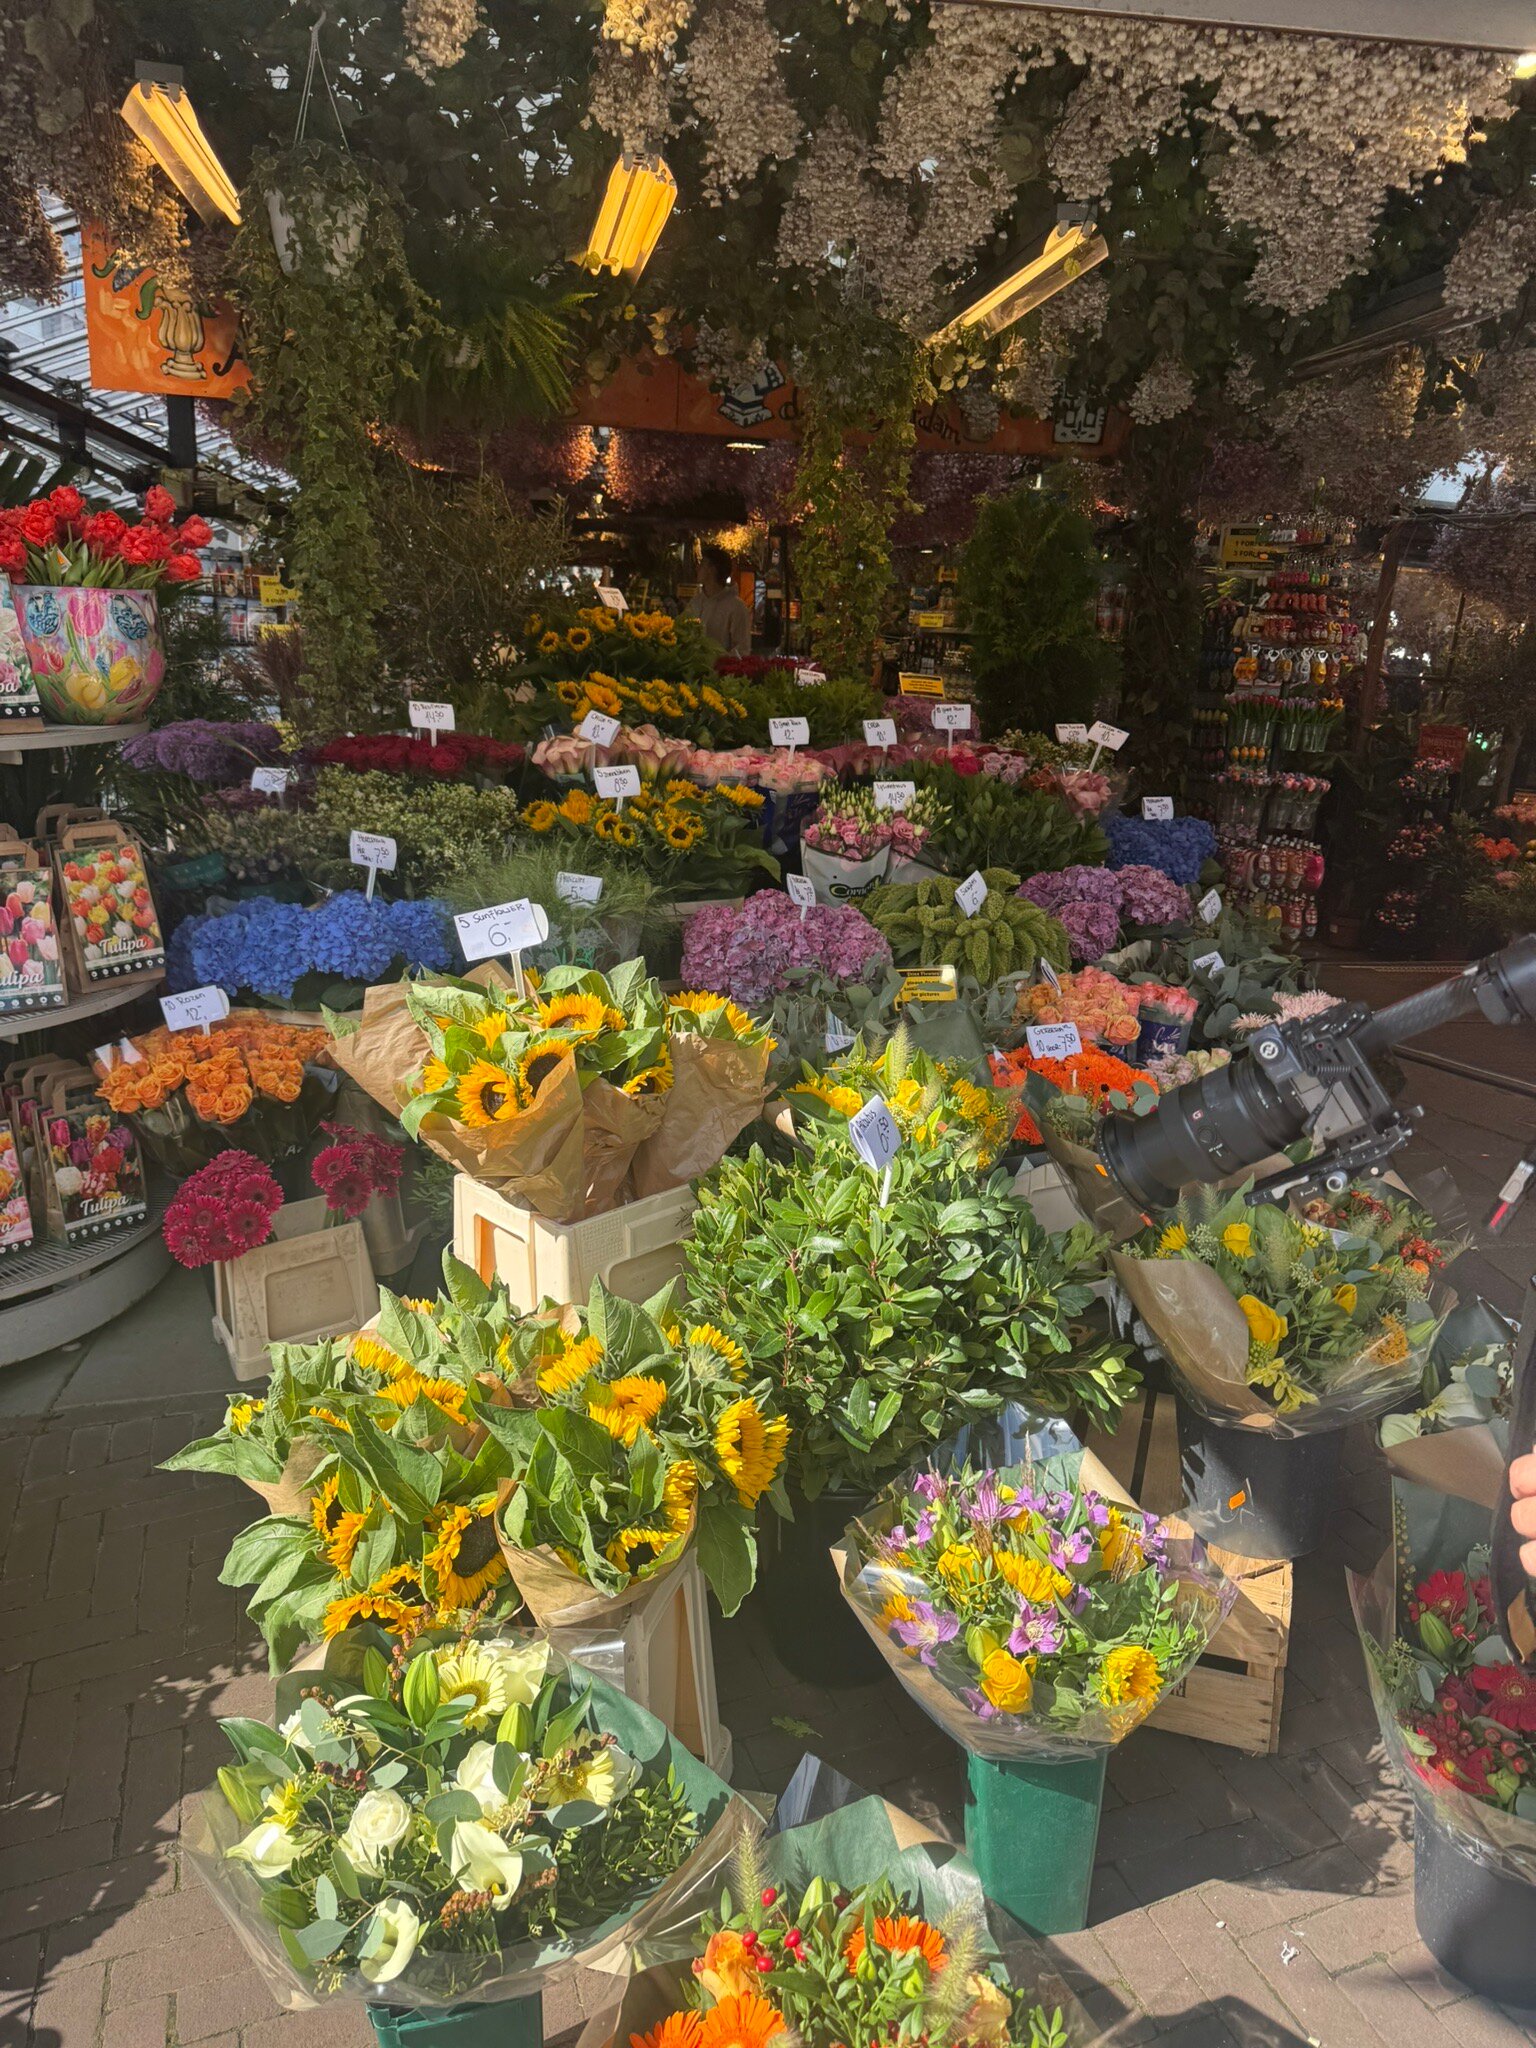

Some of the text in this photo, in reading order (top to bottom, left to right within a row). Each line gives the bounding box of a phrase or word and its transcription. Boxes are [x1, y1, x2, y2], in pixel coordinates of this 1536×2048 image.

[458, 916, 470, 928] 5
[99, 937, 147, 956] Tulipa
[0, 970, 44, 989] ulipa
[79, 1194, 129, 1217] Tulipa
